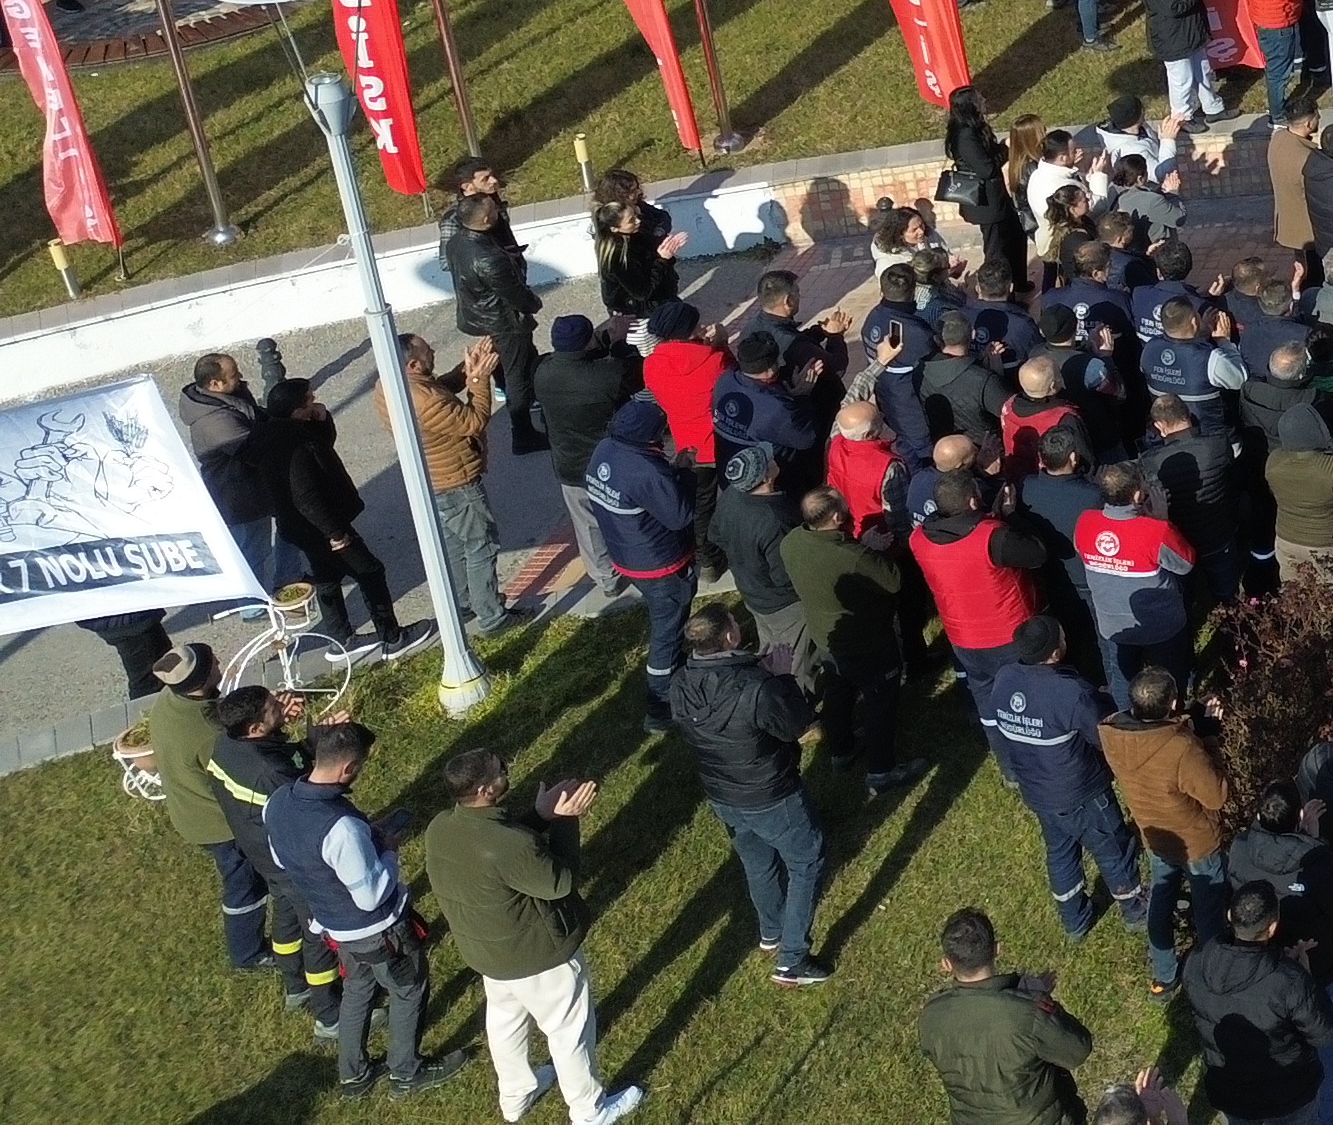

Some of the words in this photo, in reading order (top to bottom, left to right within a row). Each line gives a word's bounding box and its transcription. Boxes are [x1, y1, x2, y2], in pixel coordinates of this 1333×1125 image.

[9, 559, 30, 593] 7
[36, 547, 123, 589] NOLU
[124, 539, 205, 580] ŞUBE
